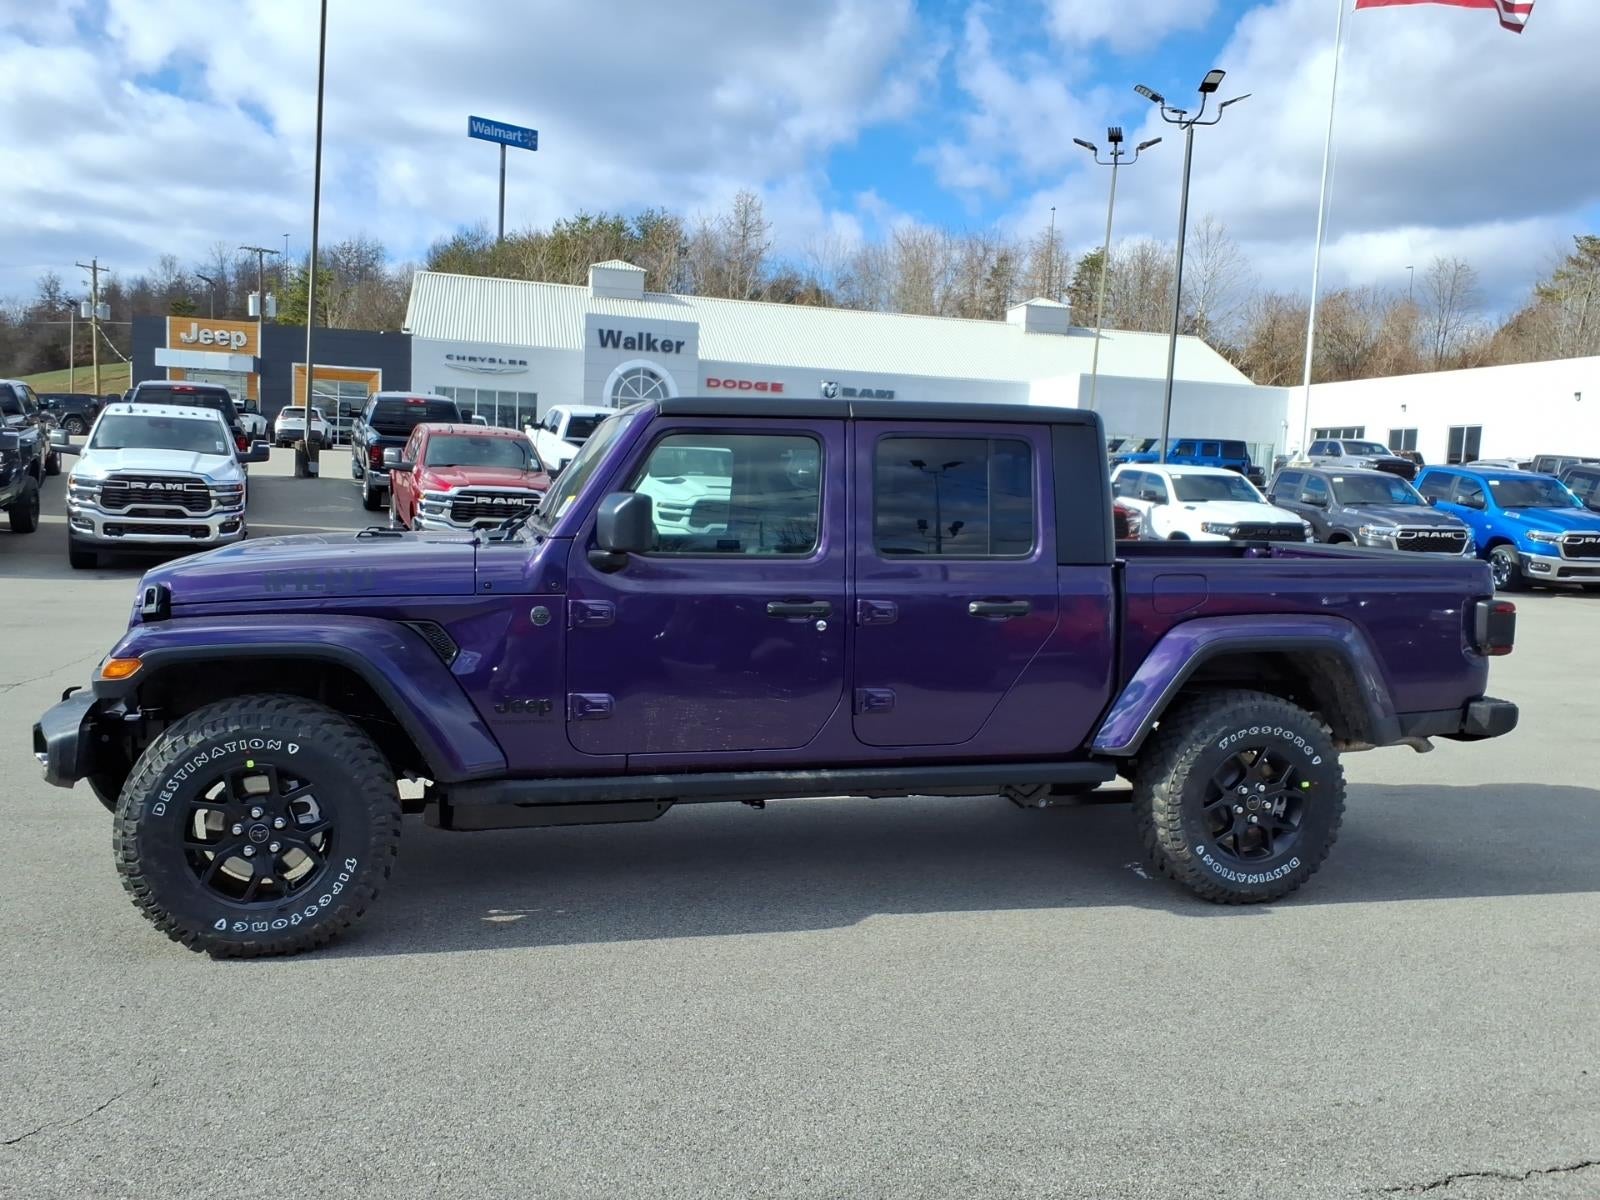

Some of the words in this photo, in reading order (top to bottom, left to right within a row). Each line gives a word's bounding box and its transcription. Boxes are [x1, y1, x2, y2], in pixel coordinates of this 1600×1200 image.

[471, 120, 523, 143] Walmart
[180, 322, 247, 350] Jeep
[598, 328, 685, 354] Walker
[445, 354, 529, 366] CHRYSLER
[706, 377, 784, 393] DODGE
[841, 386, 895, 400] RAM
[130, 482, 184, 491] RAM
[476, 496, 521, 505] RAM
[494, 695, 552, 717] Jeep
[152, 738, 283, 817] DESTINATION
[1202, 854, 1300, 884] DESTINATION
